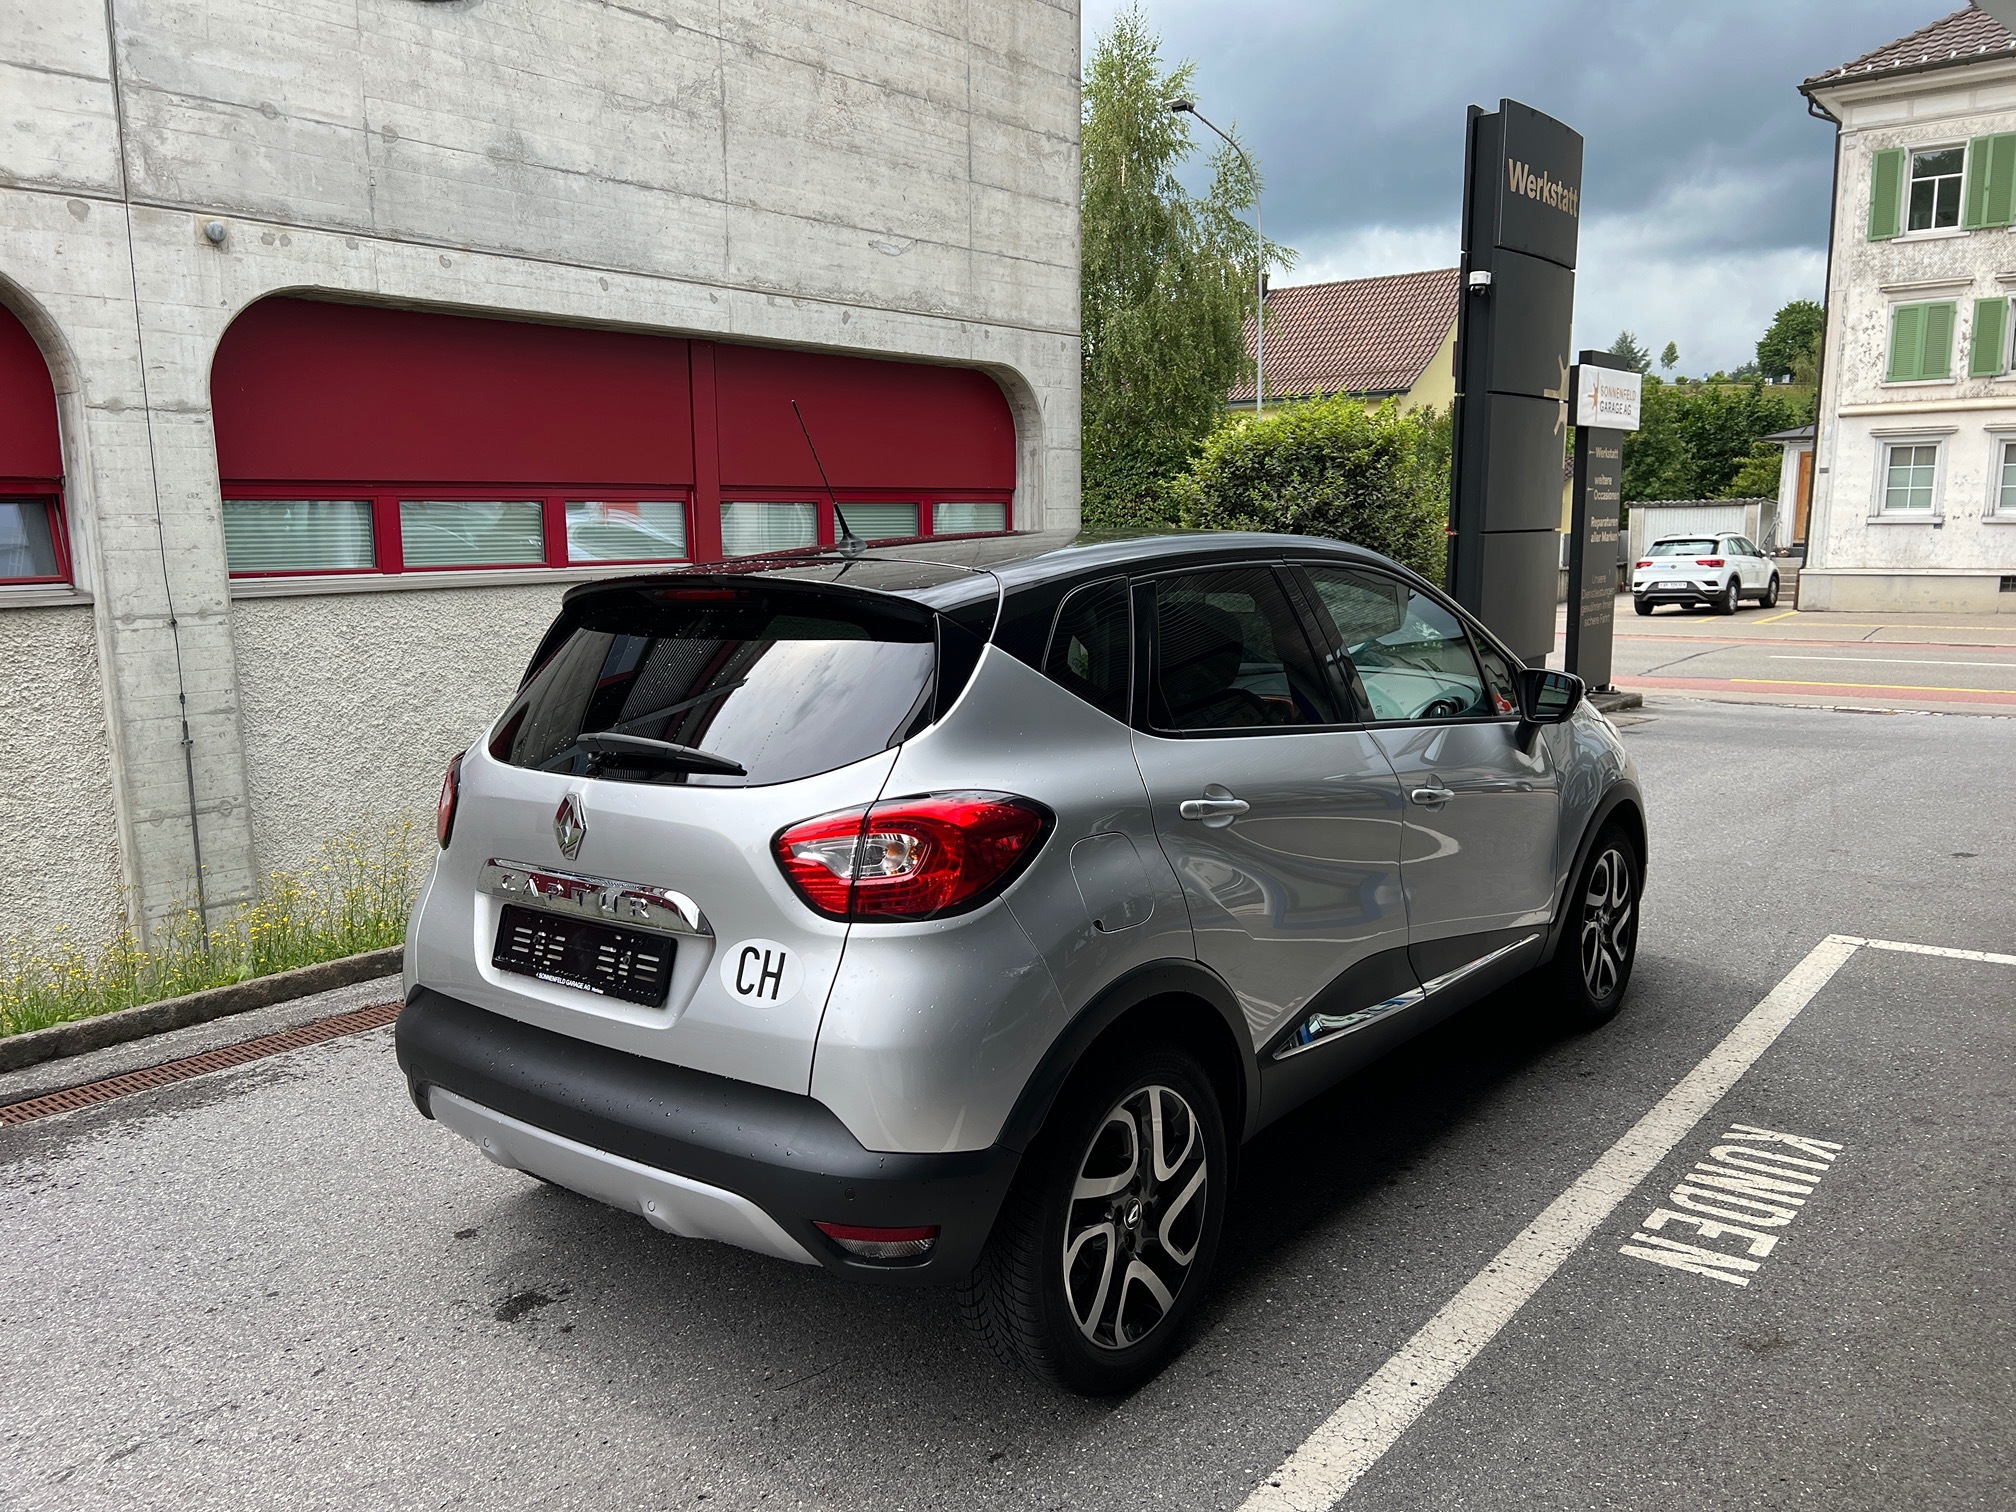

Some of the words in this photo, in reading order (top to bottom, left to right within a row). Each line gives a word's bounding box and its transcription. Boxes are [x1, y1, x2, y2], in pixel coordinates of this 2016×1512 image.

[1508, 158, 1579, 218] Werkstatt
[1600, 386, 1636, 401] SONNENFELD
[1600, 401, 1623, 414] GARAGE
[1624, 404, 1632, 416] AG
[1595, 447, 1618, 459] Werkstatt
[501, 873, 650, 919] CAPTUR
[538, 972, 566, 985] SONNENFELD
[565, 979, 584, 989] GARAGE
[735, 945, 786, 1000] CH
[1618, 1123, 1844, 1287] KUNDEN
